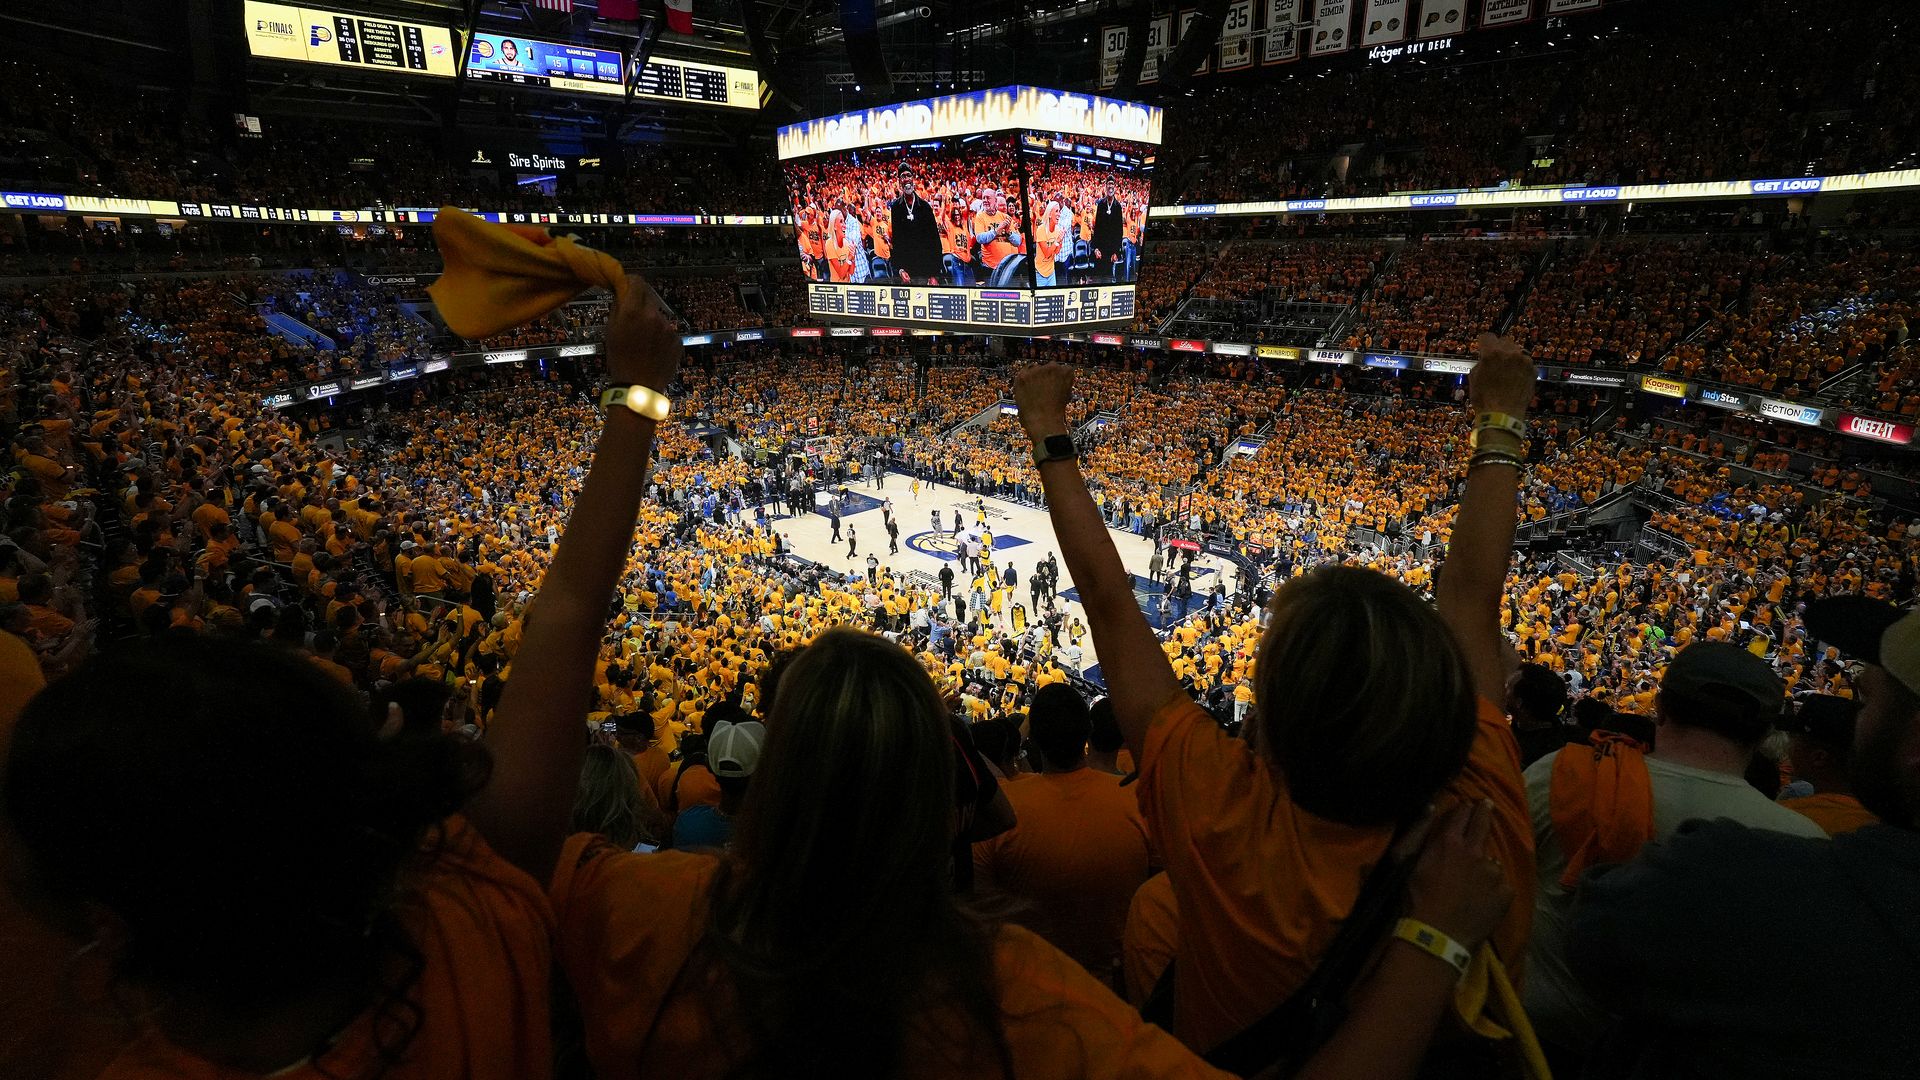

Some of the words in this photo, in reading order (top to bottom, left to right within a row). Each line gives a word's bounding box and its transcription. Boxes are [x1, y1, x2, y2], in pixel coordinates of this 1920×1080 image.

[1320, 5, 1344, 17] SIMON
[1227, 6, 1248, 30] 35
[269, 21, 293, 35] FINALS
[1147, 26, 1162, 47] 31
[1107, 32, 1127, 52] 30
[566, 48, 581, 56] GAME
[581, 50, 597, 58] STATS
[1368, 46, 1403, 64] Kroger
[1406, 41, 1424, 54] SKY
[1428, 38, 1452, 51] DECK
[553, 60, 562, 68] 15
[599, 65, 617, 75] 4/10
[508, 153, 531, 168] Sire
[531, 154, 566, 171] Spirits
[1753, 181, 1781, 192] GET
[1782, 179, 1820, 191] LOUD
[1563, 190, 1584, 200] GET
[1585, 189, 1617, 198] LOUD
[5, 194, 30, 206] GET
[30, 195, 64, 208] LOUD
[1288, 202, 1303, 210] GET
[1303, 200, 1324, 209] LOUD
[1411, 197, 1429, 205] GET
[1430, 195, 1455, 204] LOUD
[181, 207, 201, 216] 14/35
[213, 209, 231, 217] 14/19
[242, 210, 260, 219] 31/72
[1185, 205, 1198, 214] GET
[1198, 205, 1216, 213] LOUD
[513, 214, 525, 222] 90
[613, 215, 623, 223] 60
[899, 290, 909, 298] 0.0
[1088, 291, 1097, 300] 0.0
[915, 308, 924, 316] 60
[1067, 311, 1076, 319] 90
[1100, 308, 1108, 317] 60
[1316, 351, 1345, 360] IBEW
[1424, 359, 1448, 371] aes
[1449, 364, 1471, 373] Indian
[1569, 373, 1593, 381] Fanatics
[1645, 377, 1680, 391] Koorsen
[1761, 403, 1801, 417] SECTION
[1801, 408, 1817, 421] 127
